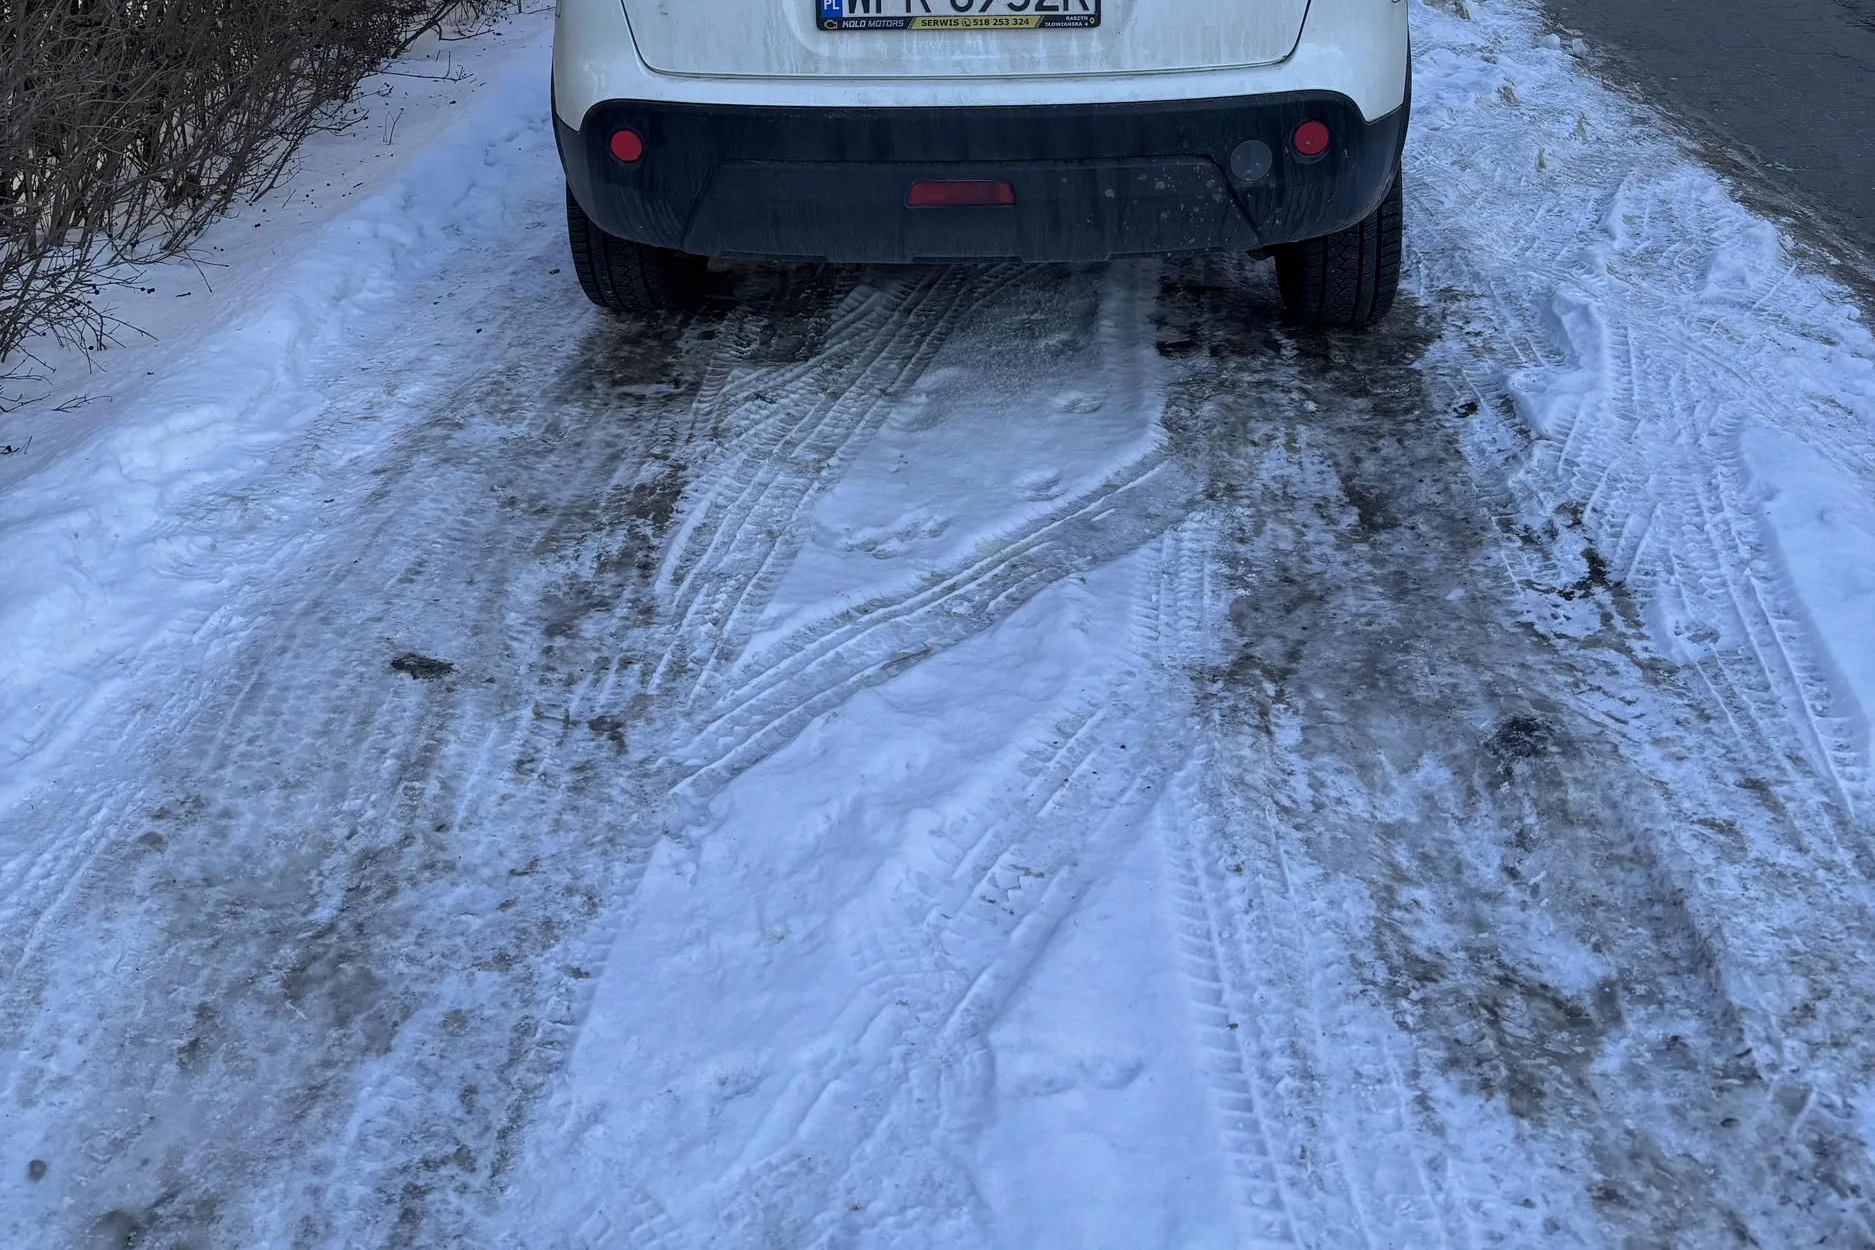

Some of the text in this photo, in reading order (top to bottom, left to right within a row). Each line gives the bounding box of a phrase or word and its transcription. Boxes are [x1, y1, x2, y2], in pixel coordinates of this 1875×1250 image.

[842, 19, 904, 28] KOLO MOTORS
[921, 18, 1029, 27] SERWIS 518 253 324
